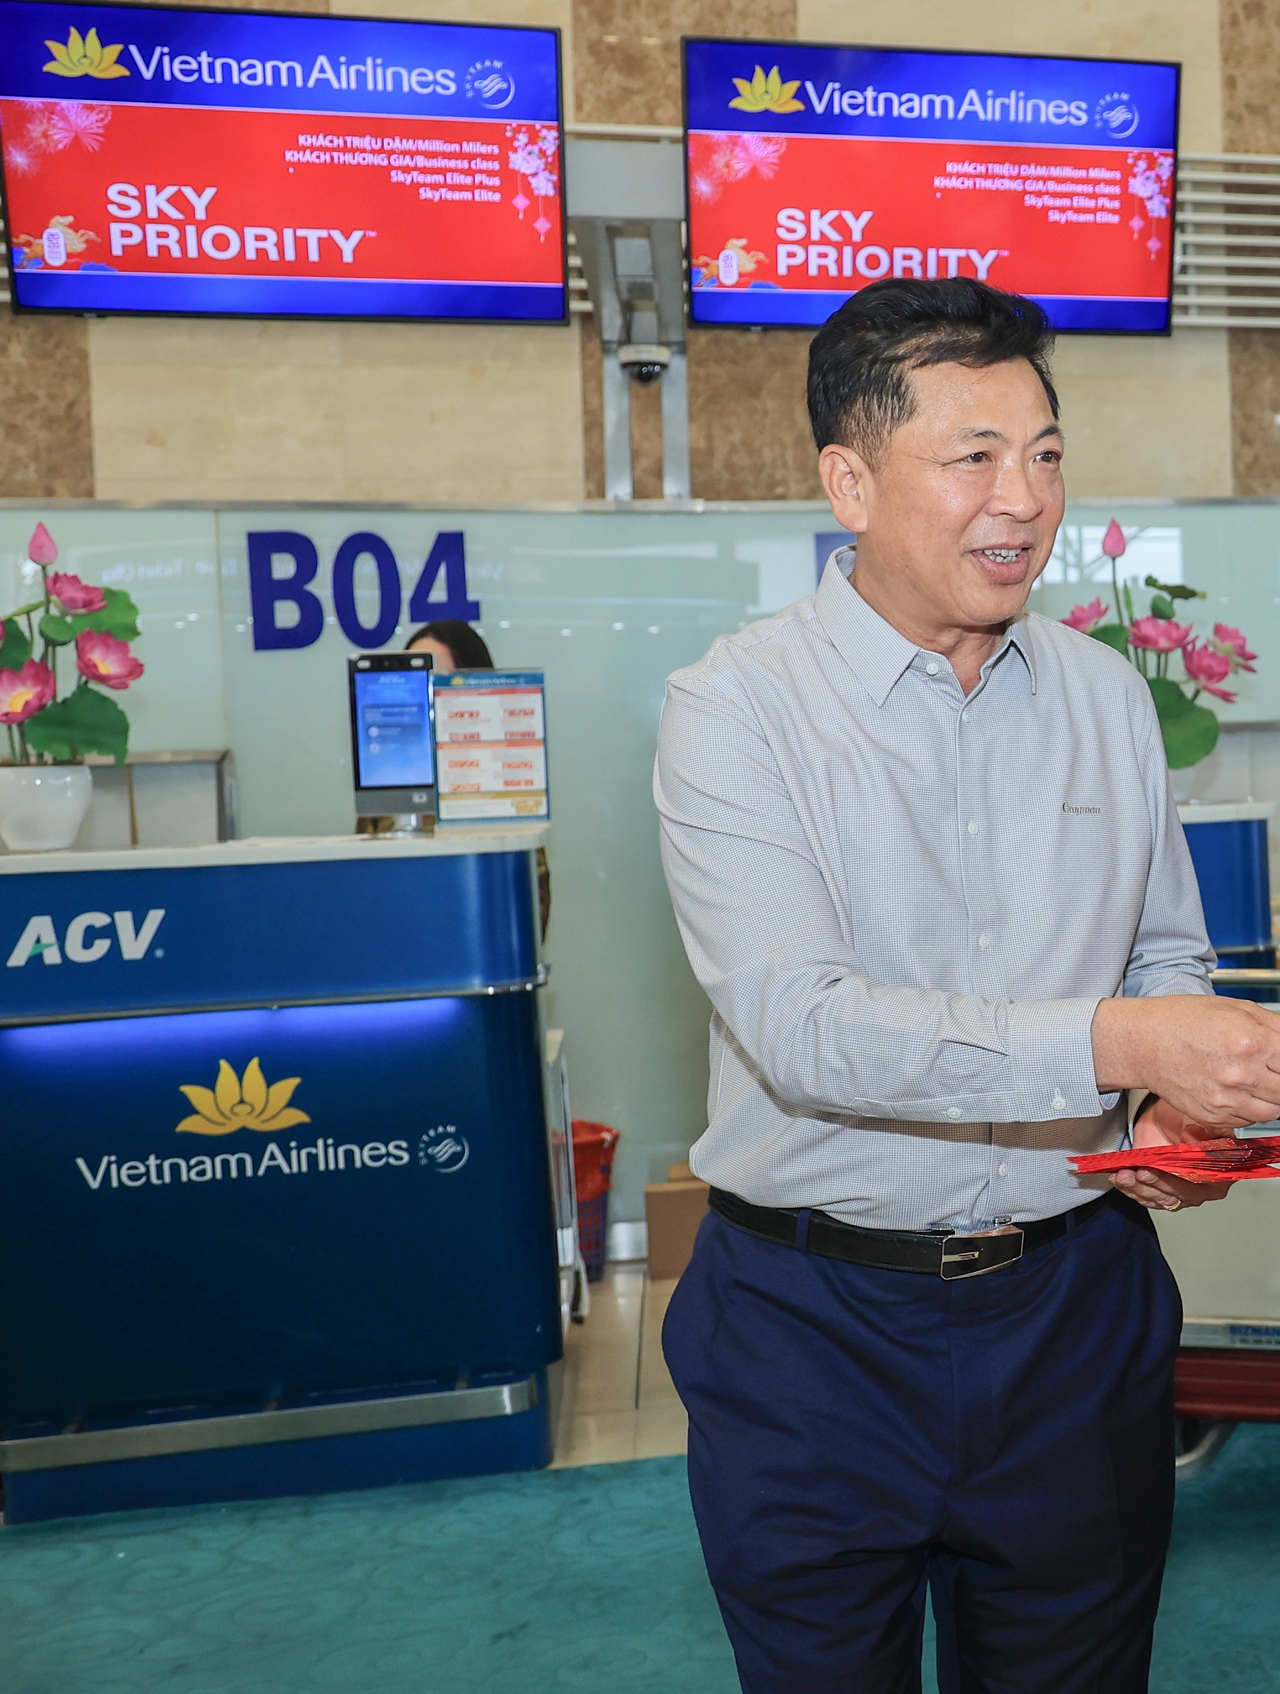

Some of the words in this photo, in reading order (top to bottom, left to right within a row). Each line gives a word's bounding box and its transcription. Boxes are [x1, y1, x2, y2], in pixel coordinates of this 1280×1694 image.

[128, 45, 301, 88] Vietnam
[307, 55, 457, 96] Airlines
[803, 80, 955, 121] Vietnam
[956, 88, 1088, 126] Airlines
[285, 149, 332, 164] KHÁCH
[333, 151, 389, 167] THƯƠNG
[470, 157, 501, 171] class
[298, 133, 345, 149] KHÁCH
[345, 135, 382, 152] TRIỆU
[462, 140, 500, 154] Milers
[390, 169, 445, 186] SkyTeam
[446, 172, 474, 185] Elite
[475, 173, 501, 187] Plus
[933, 175, 975, 189] KHÁCH
[1094, 182, 1122, 195] class
[946, 161, 987, 175] KHÁCH
[107, 182, 218, 220] SKY
[419, 187, 473, 202] SkyTeam
[473, 188, 502, 203] Elite
[1024, 194, 1072, 210] SkyTeam
[1072, 195, 1096, 208] Elite
[1097, 196, 1122, 209] Plus
[775, 207, 873, 242] SKY
[1048, 209, 1095, 224] SkyTeam
[1096, 211, 1121, 224] Elite
[109, 223, 367, 263] PRIORITY
[776, 244, 999, 280] PRIORITY
[247, 531, 480, 650] B04
[6, 909, 165, 967] ACV
[76, 1146, 253, 1190] Vietnam
[257, 1138, 410, 1177] Airlines
